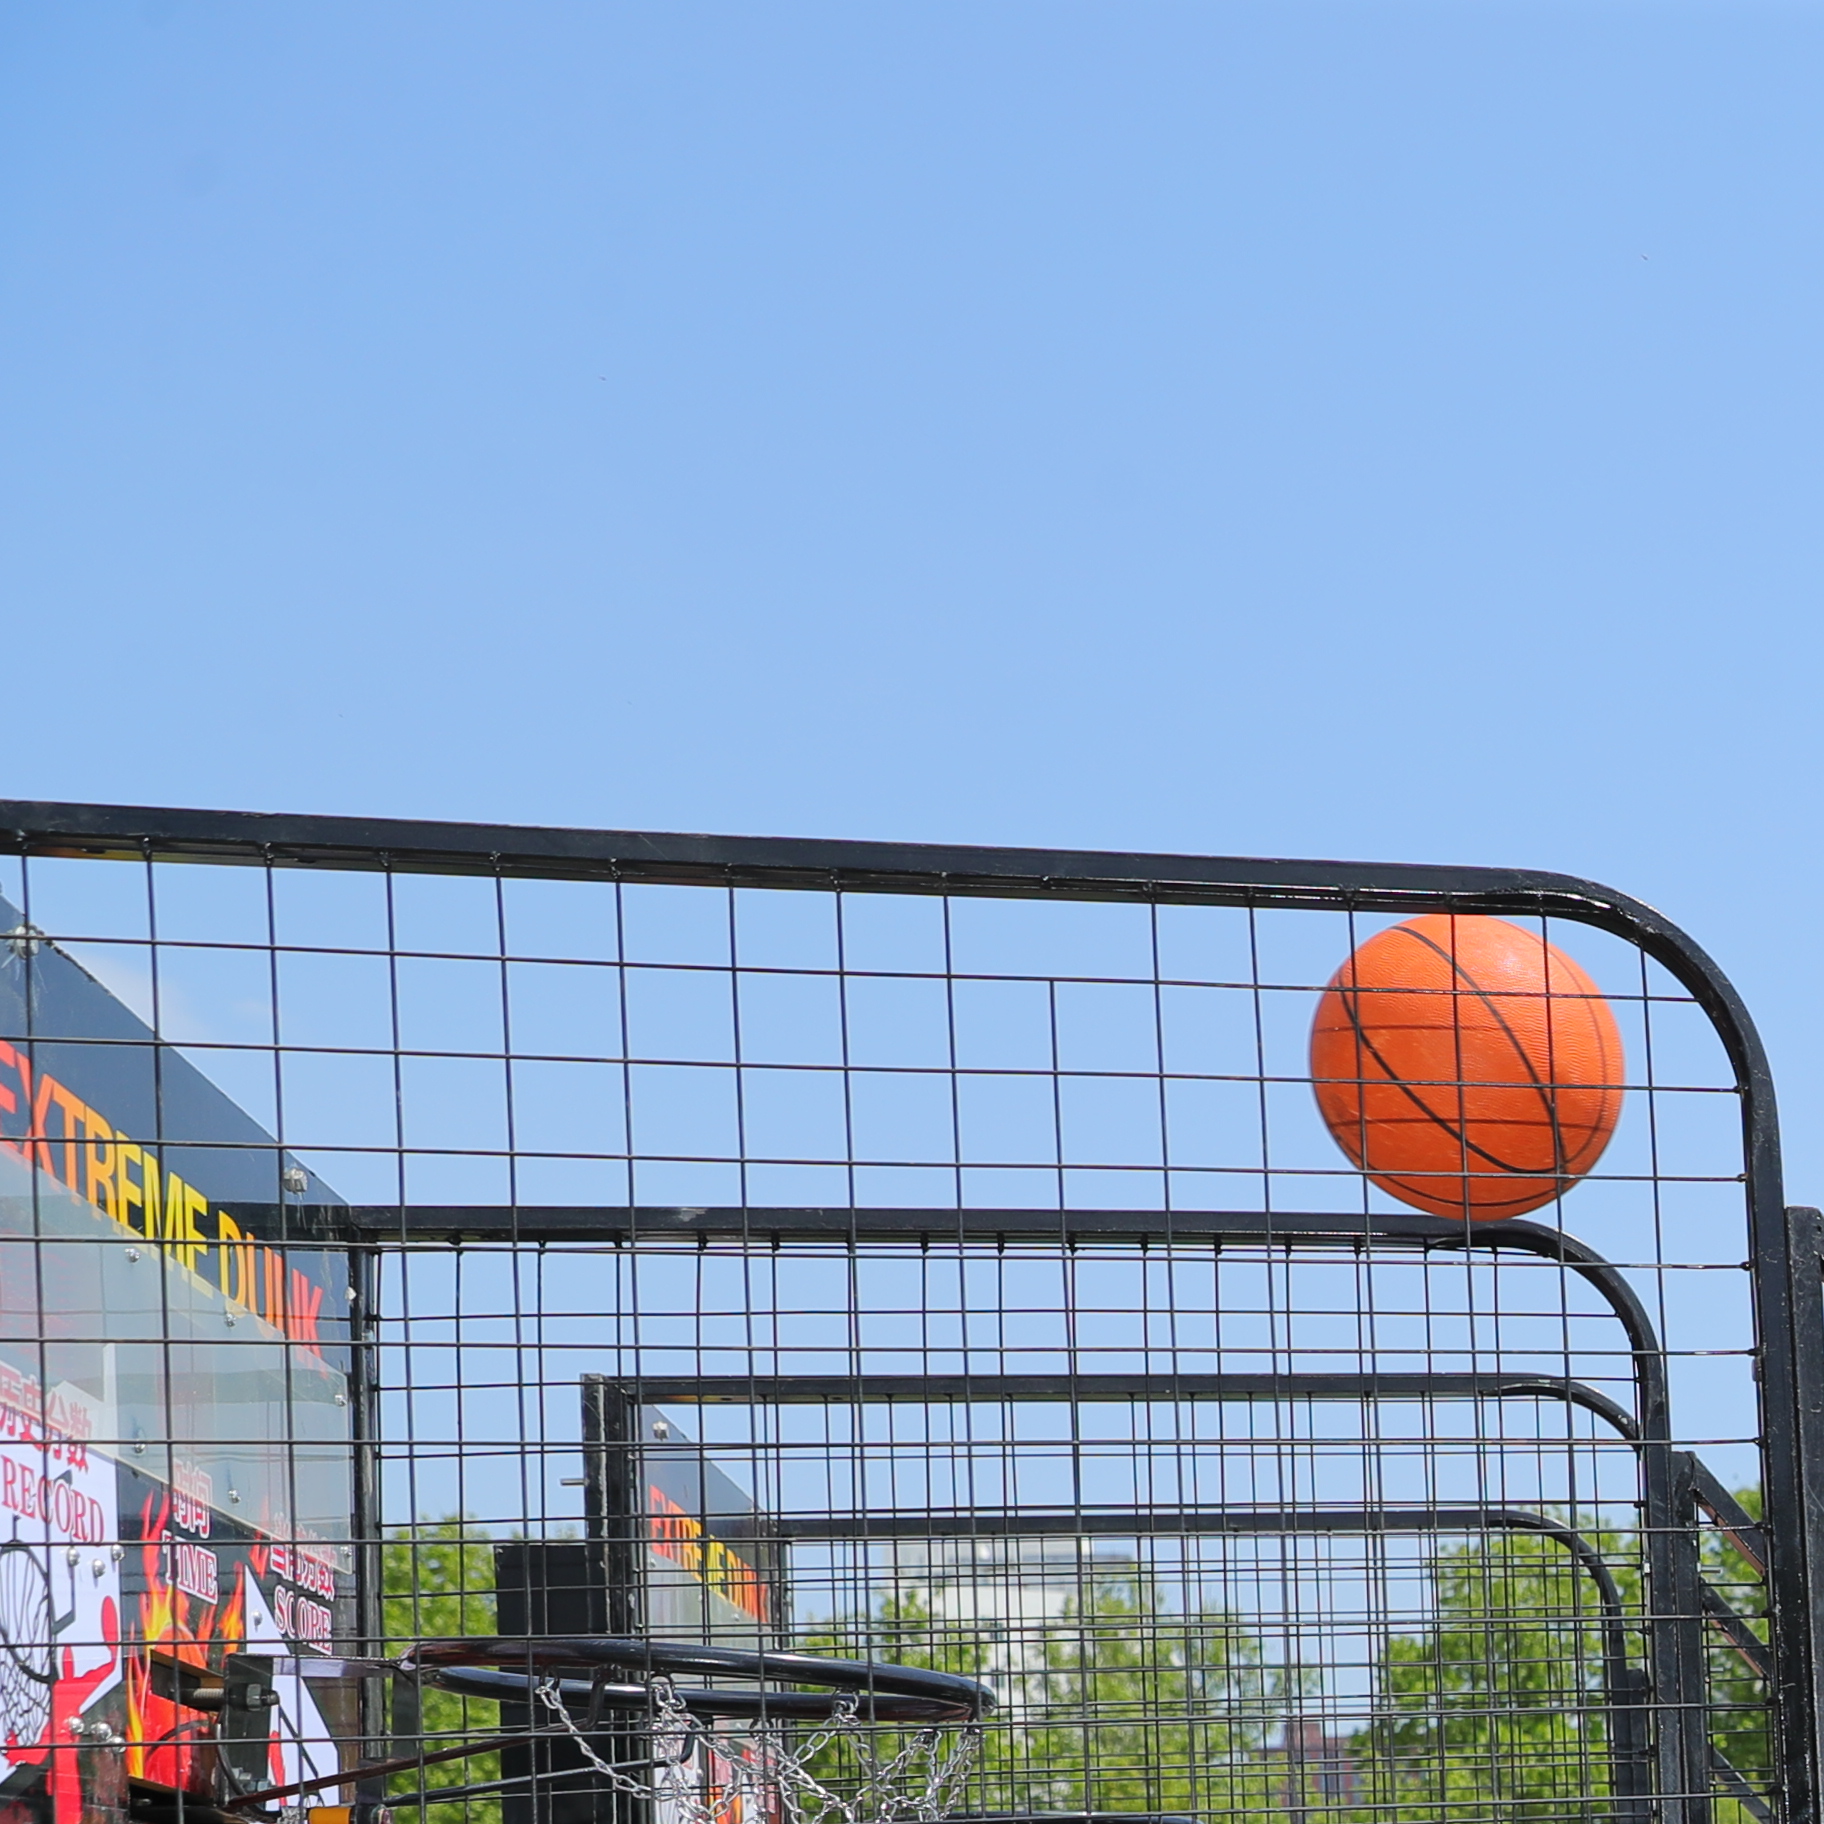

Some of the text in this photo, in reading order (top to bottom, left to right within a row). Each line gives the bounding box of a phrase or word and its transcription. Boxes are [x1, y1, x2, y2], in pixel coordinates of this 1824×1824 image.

[0, 1040, 328, 1380] EXTREME DUNK
[1, 1454, 104, 1547] RECORD
[162, 1530, 218, 1605] TIME
[275, 1585, 332, 1655] SCORE
